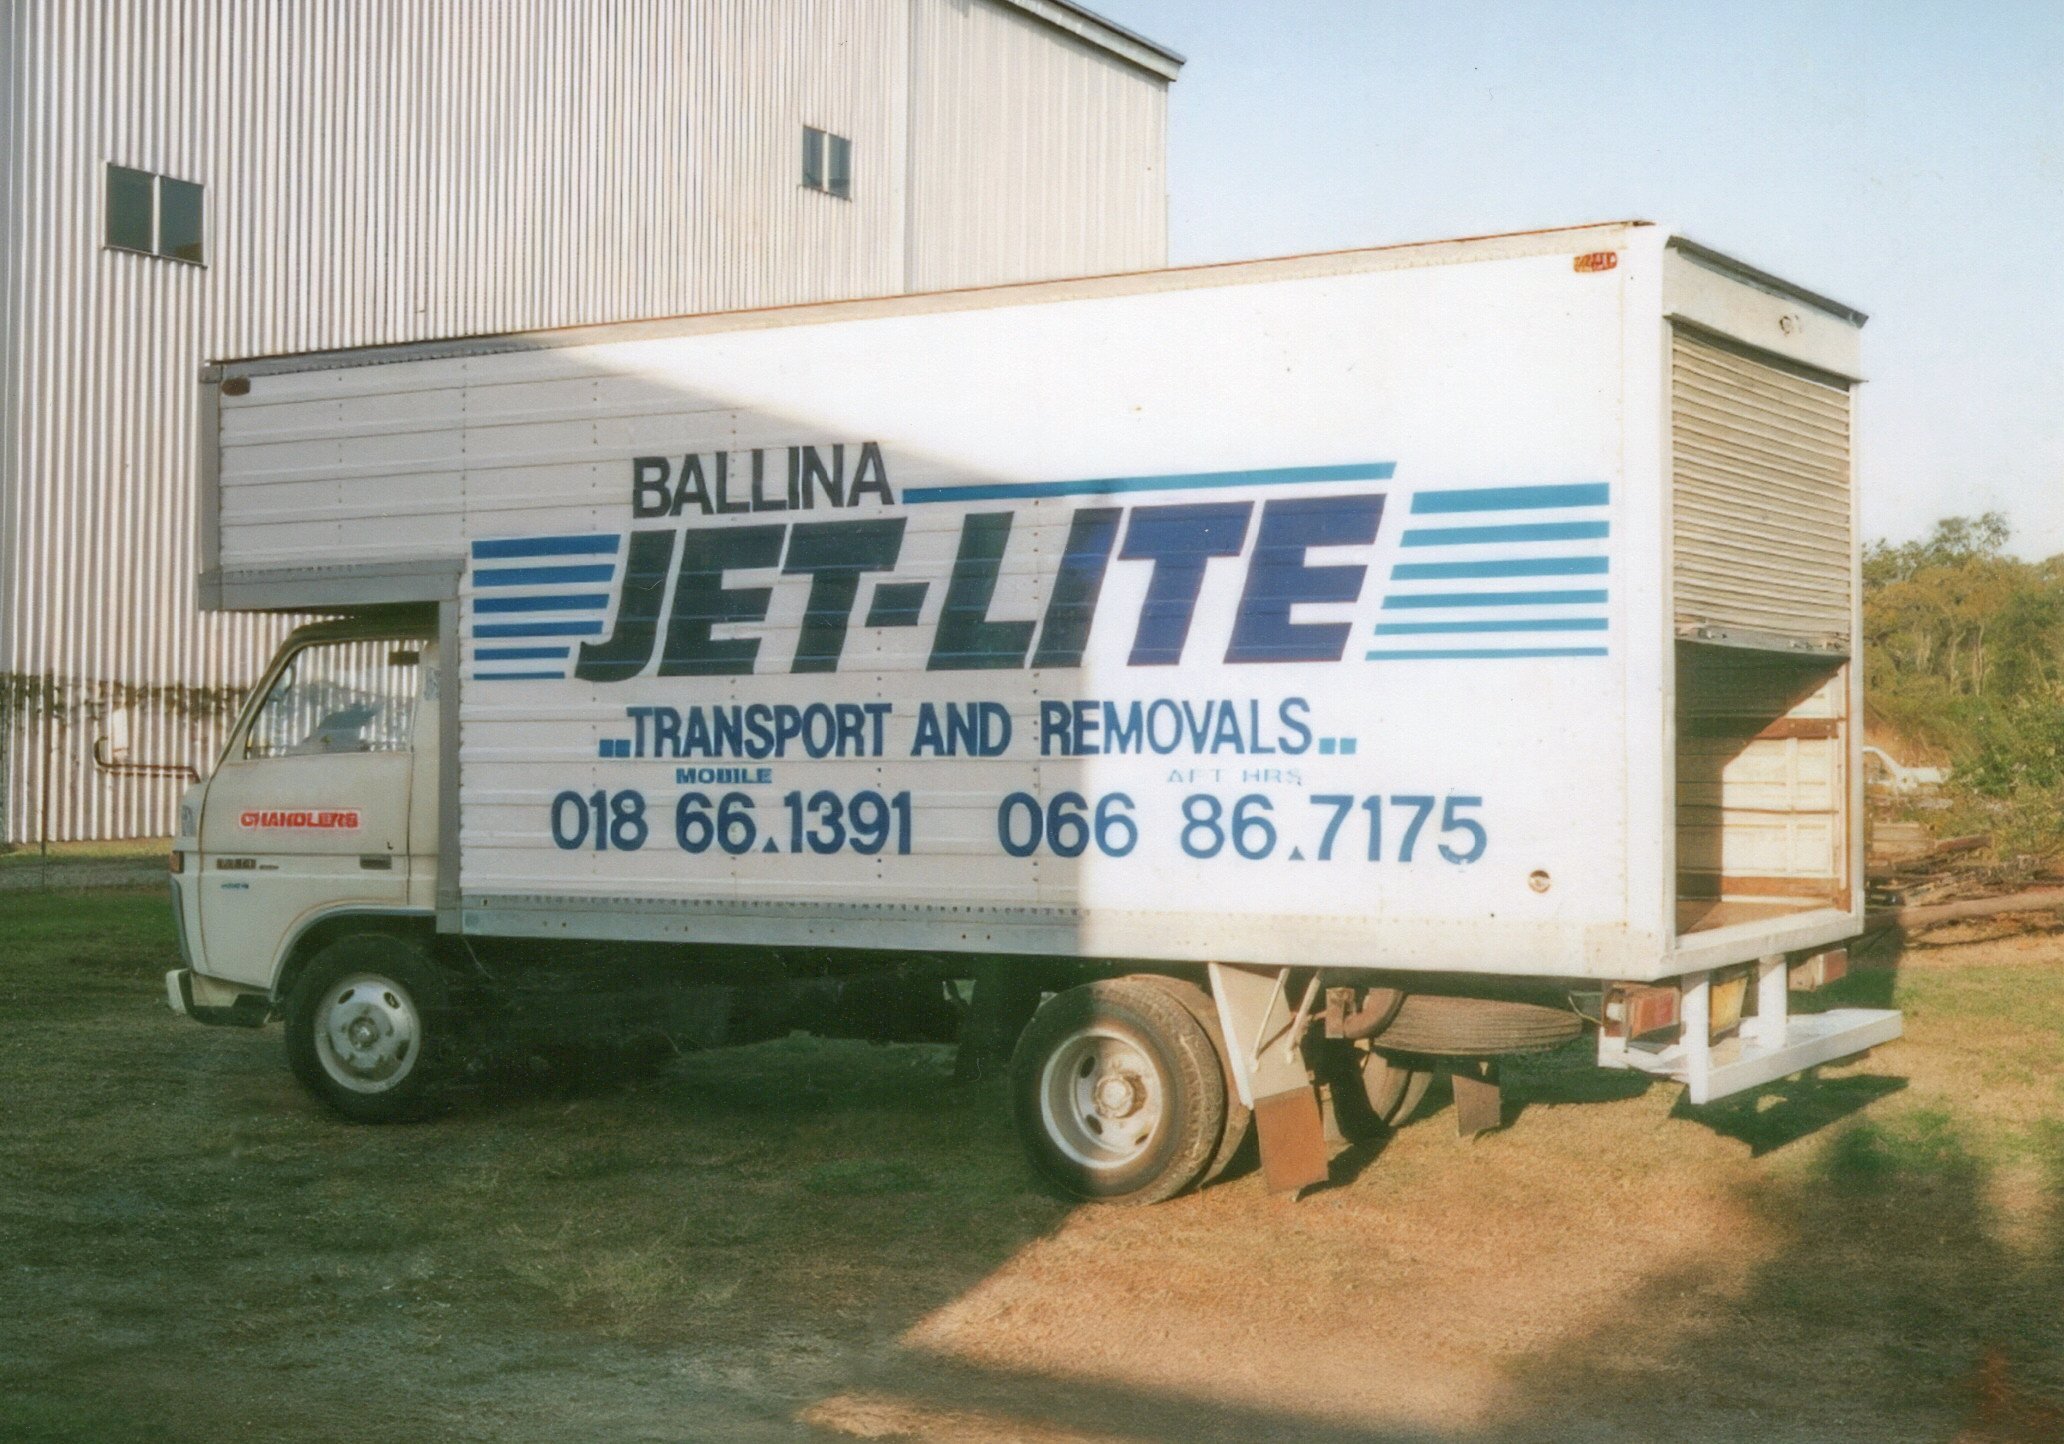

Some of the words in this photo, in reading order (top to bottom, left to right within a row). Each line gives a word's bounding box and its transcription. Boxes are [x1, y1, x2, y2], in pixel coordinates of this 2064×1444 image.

[632, 441, 895, 518] BALLINA
[574, 492, 1388, 682] JET-LITE
[910, 700, 1012, 757] AND
[676, 767, 773, 784] MOBILE
[1242, 768, 1301, 785] HRS
[240, 811, 359, 828] CHANDLERS
[551, 788, 649, 852] 018
[998, 791, 1138, 858] 066
